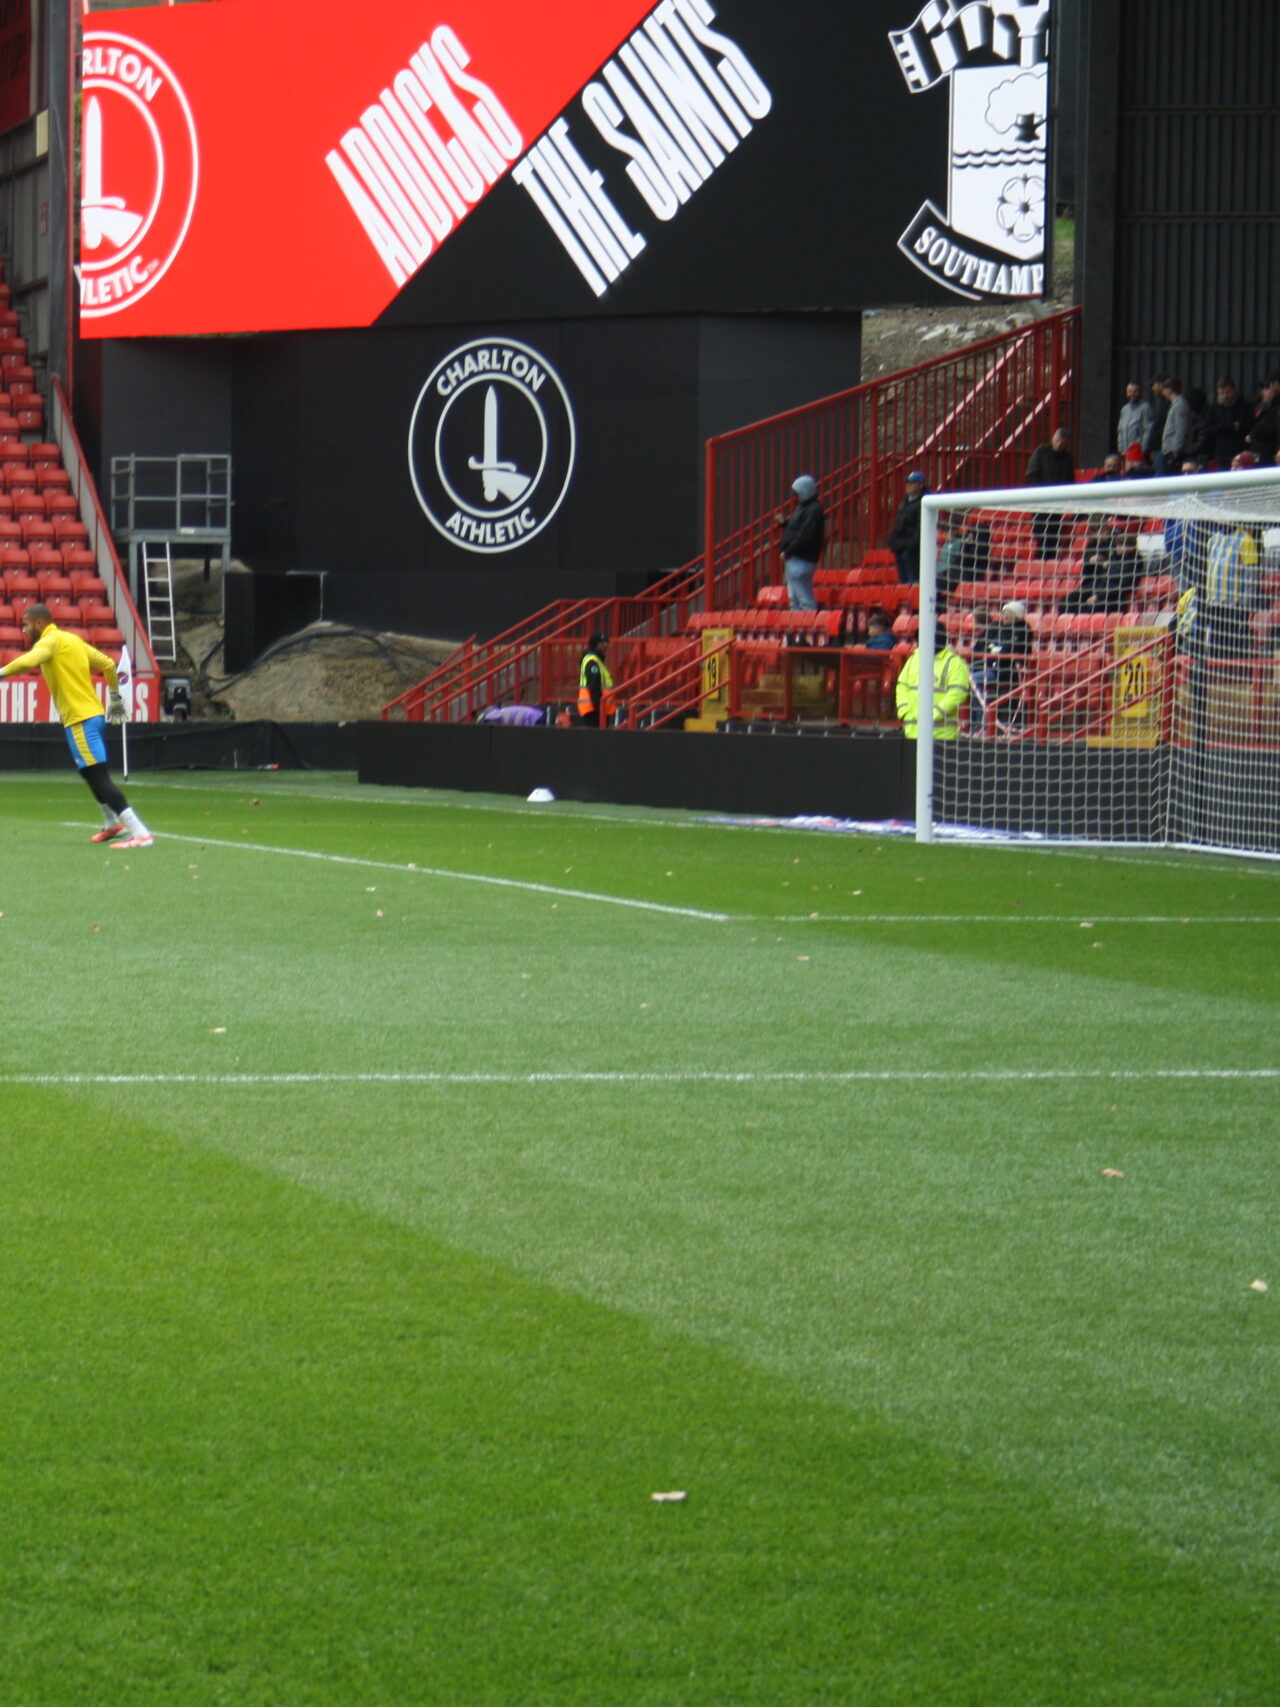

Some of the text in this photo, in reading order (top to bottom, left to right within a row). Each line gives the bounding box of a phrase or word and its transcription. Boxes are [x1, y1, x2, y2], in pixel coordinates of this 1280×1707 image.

[325, 24, 523, 288] ADDICKS
[511, 0, 772, 297] THE SAINTS
[436, 348, 546, 396] CHARLTON
[445, 507, 536, 544] ATHLETIC
[1124, 662, 1145, 702] 20
